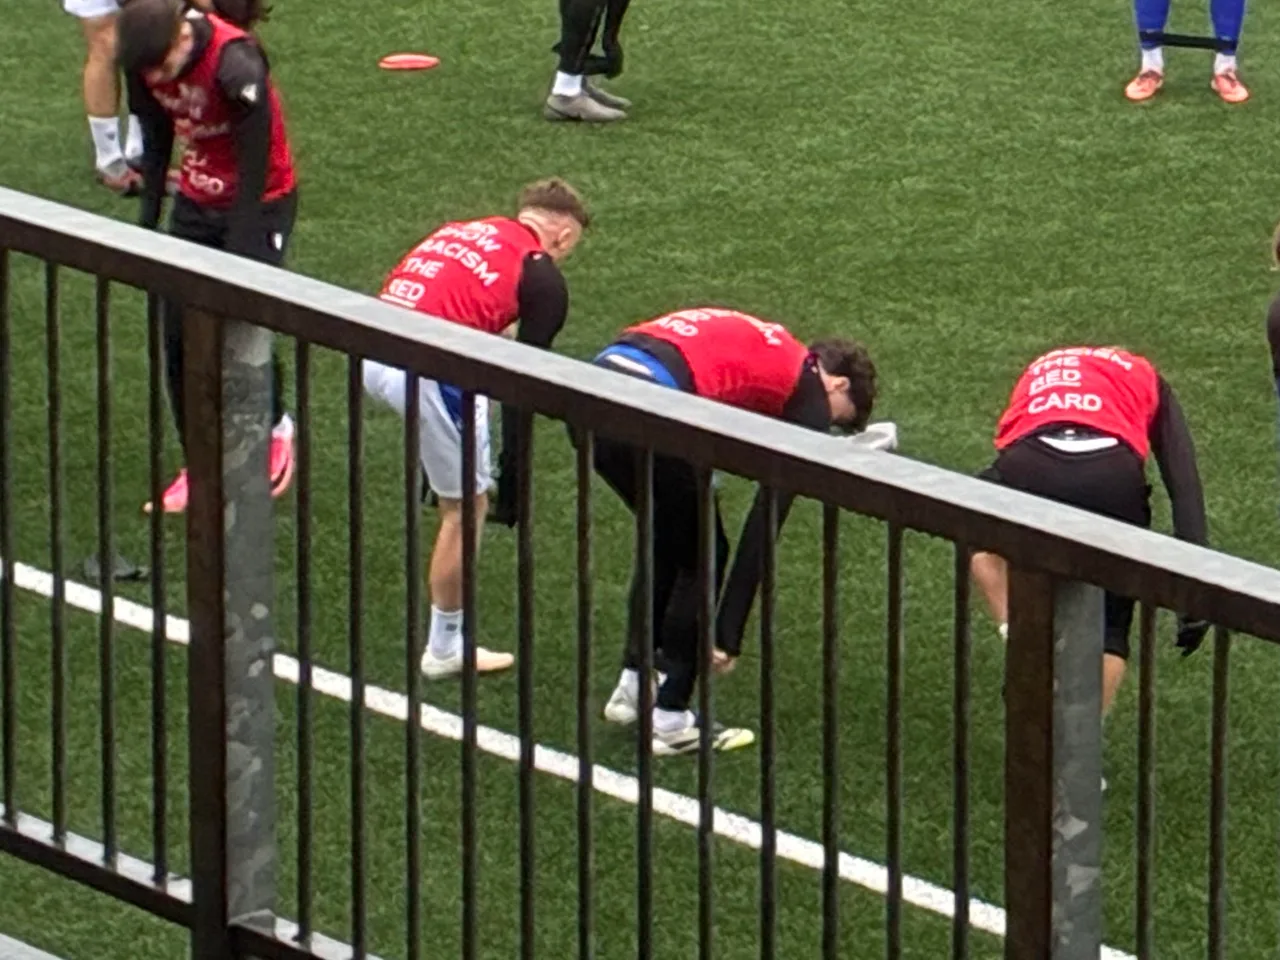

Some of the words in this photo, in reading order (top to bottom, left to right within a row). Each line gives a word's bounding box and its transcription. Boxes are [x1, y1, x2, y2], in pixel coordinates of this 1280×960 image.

[401, 255, 446, 280] THE
[419, 238, 501, 288] RACISM
[1028, 392, 1103, 415] CARD
